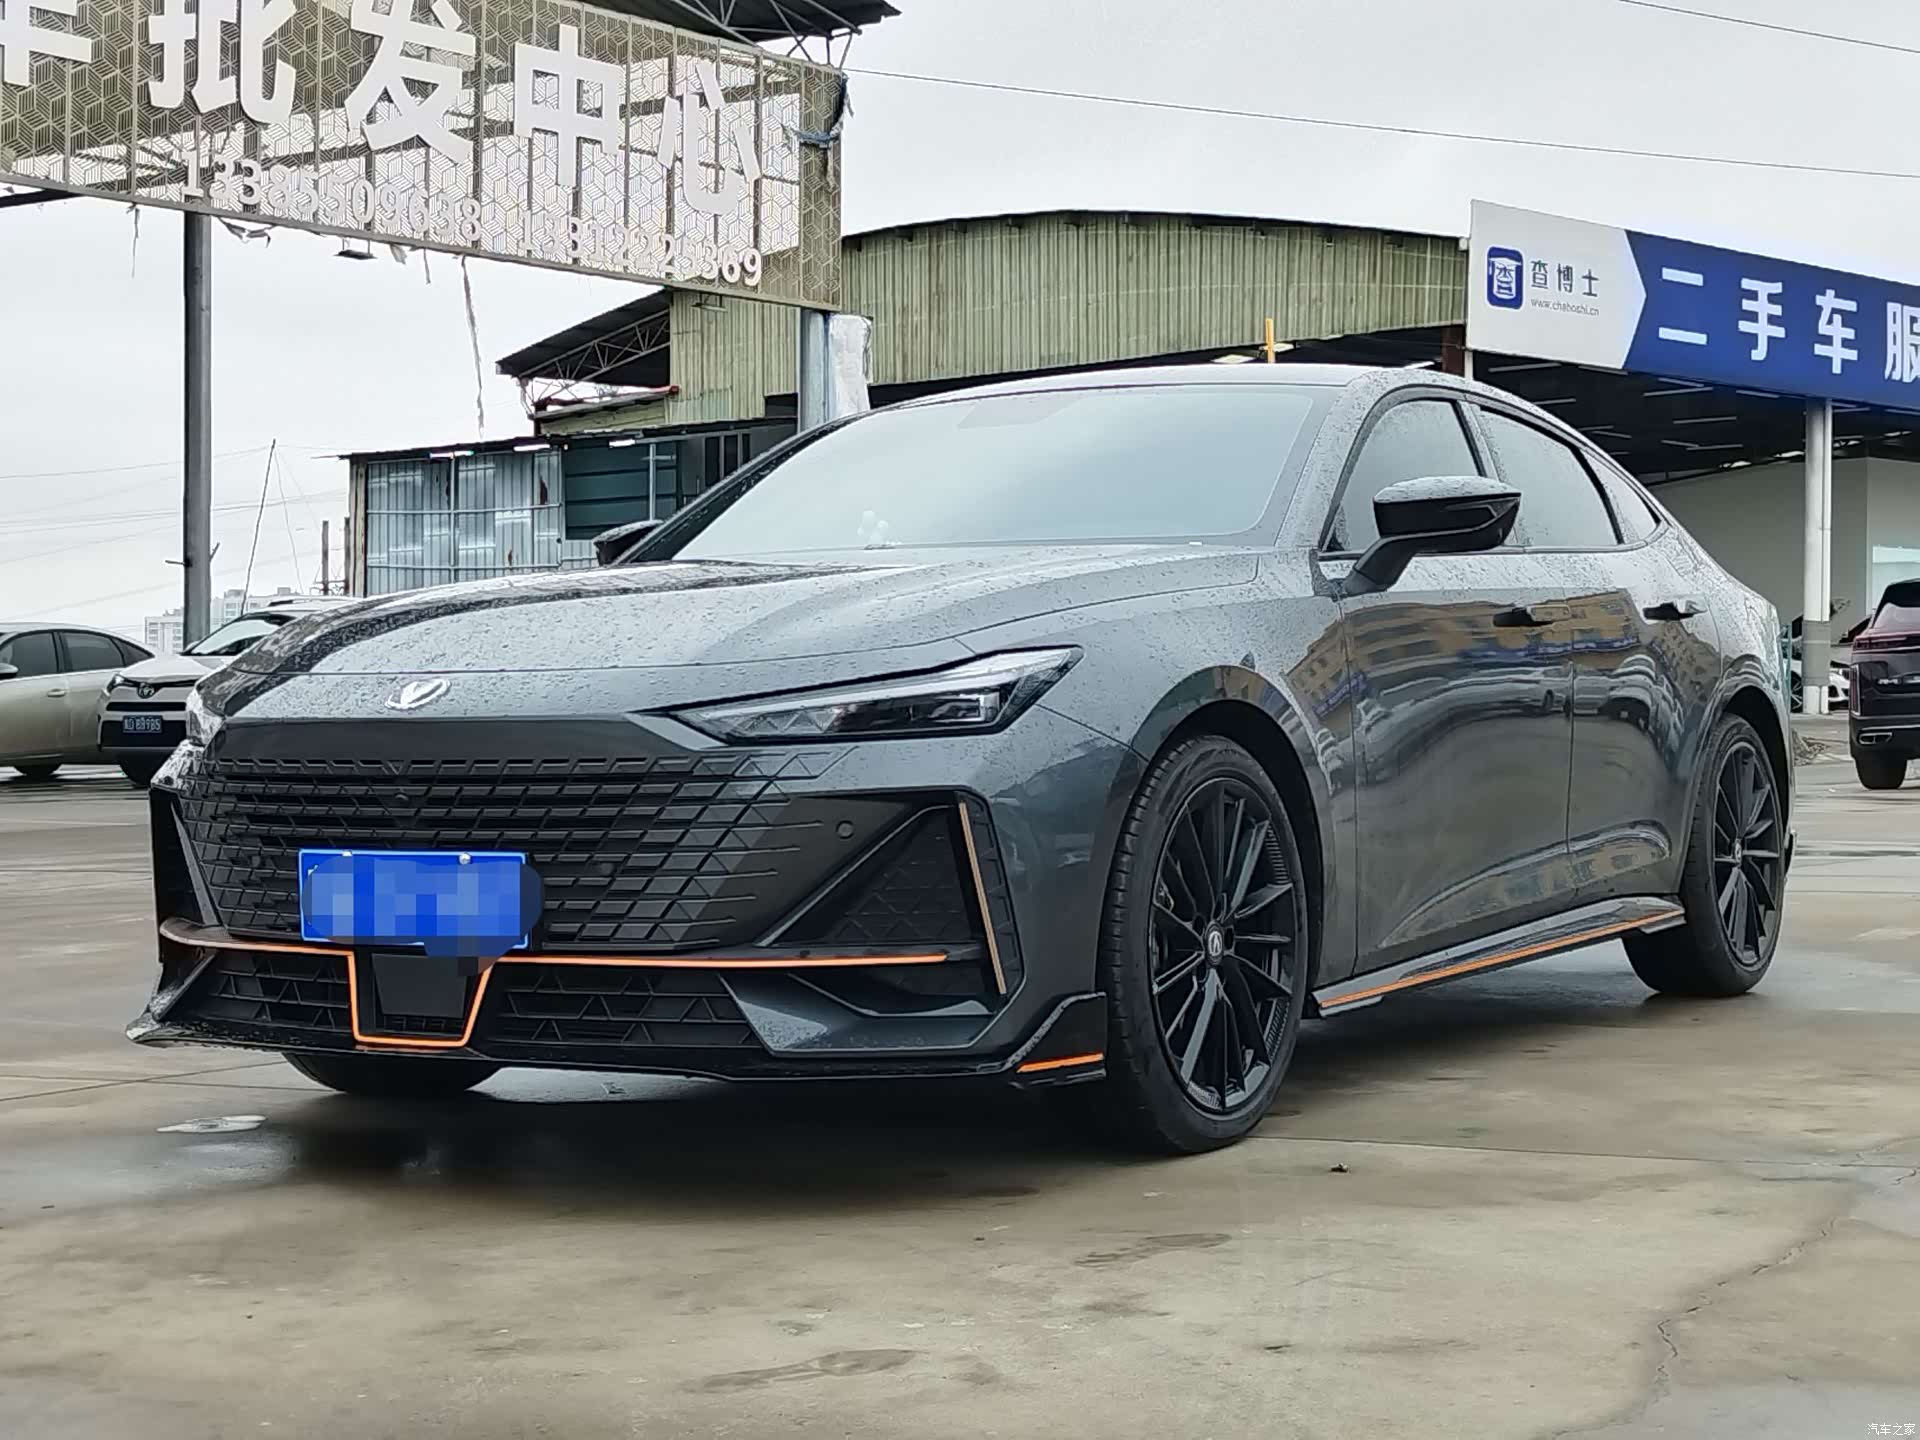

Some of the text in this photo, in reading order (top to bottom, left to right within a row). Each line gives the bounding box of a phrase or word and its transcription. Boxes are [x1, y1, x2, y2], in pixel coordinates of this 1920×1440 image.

[180, 149, 483, 242] 13385509638
[1530, 259, 1600, 297] 查博士
[1658, 266, 1920, 384] 二手车服
